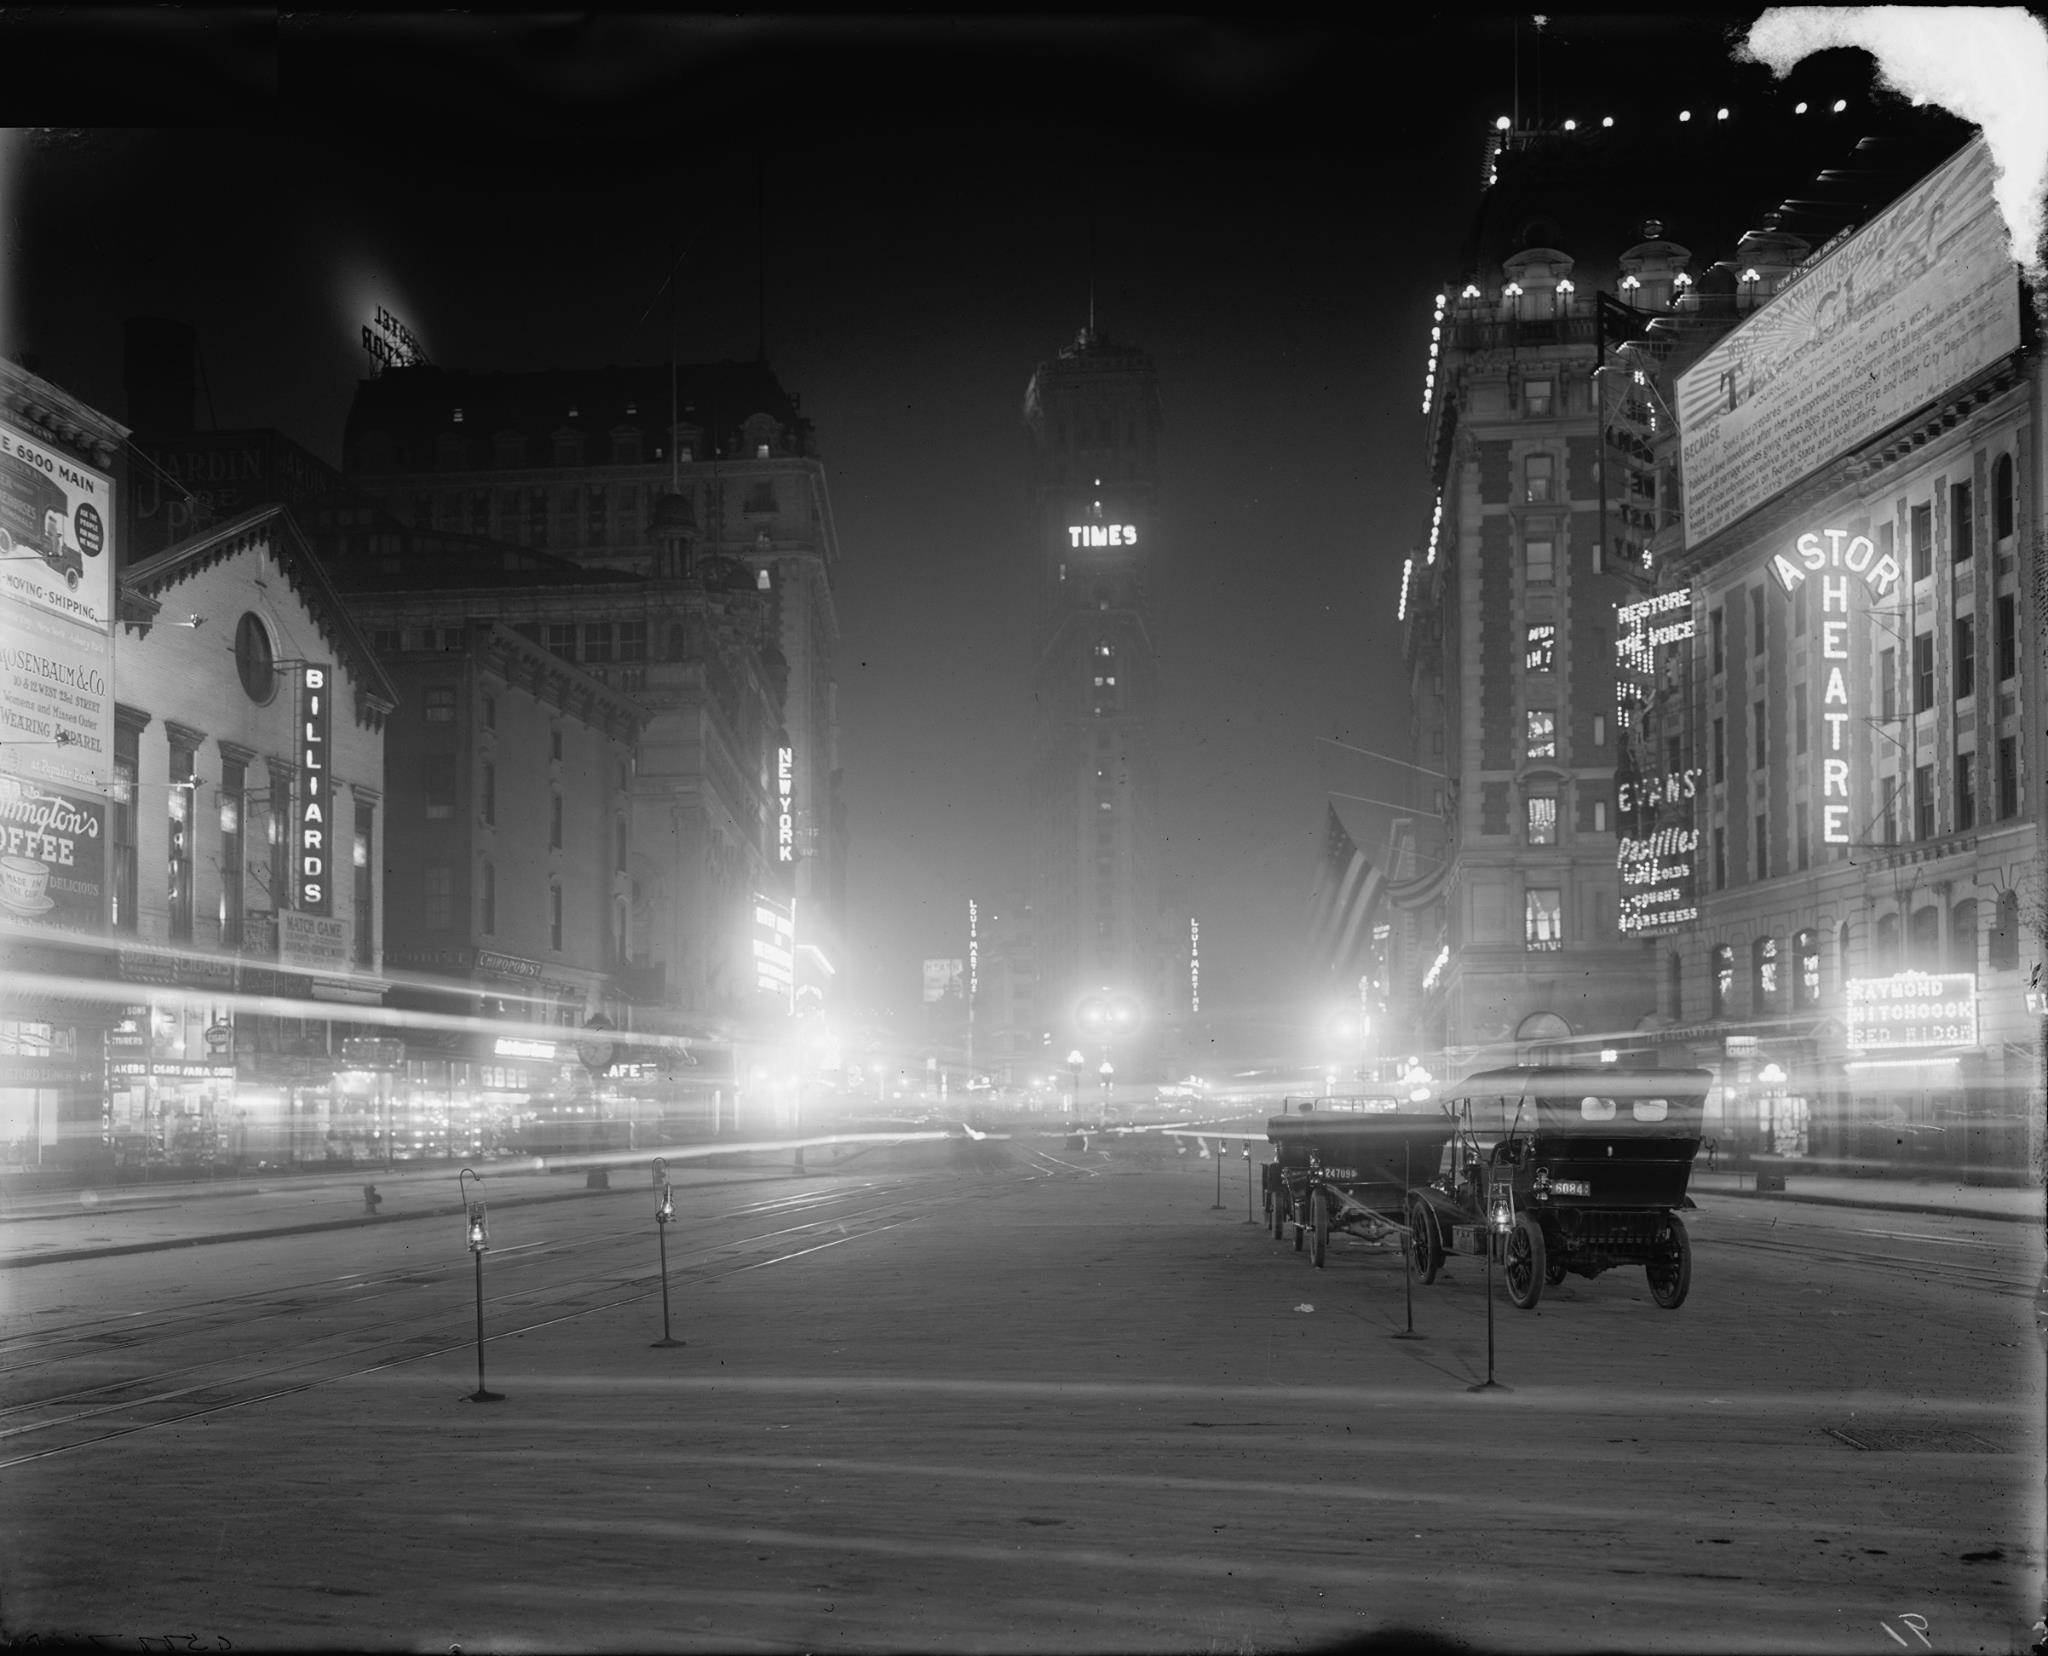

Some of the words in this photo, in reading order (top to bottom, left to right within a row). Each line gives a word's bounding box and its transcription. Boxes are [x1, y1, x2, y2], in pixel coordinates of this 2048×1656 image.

[1683, 422, 1721, 463] BECAUSE
[17, 445, 54, 473] 6900
[59, 465, 94, 494] MAIN
[1068, 524, 1137, 548] TIMES
[1773, 528, 1901, 596] ASTOR
[1617, 588, 1692, 625] RESTORE
[1614, 634, 1647, 657] THE
[1648, 620, 1696, 647] VOICE
[38, 682, 58, 699] WEST
[75, 695, 101, 714] STREET
[0, 706, 50, 738] WEARING
[304, 668, 324, 902] BILLIARDS
[778, 747, 793, 795] NEW
[778, 797, 793, 862] YORK
[49, 875, 100, 897] DELICIOUS
[316, 920, 344, 939] GAME
[968, 899, 978, 938] LOUIS
[1190, 917, 1200, 957] LOUIS
[479, 953, 542, 977] CHIROPODIST
[1852, 979, 1944, 1000] RAYMOND
[1854, 1027, 1891, 1043] RED
[602, 1064, 641, 1078] AFE
